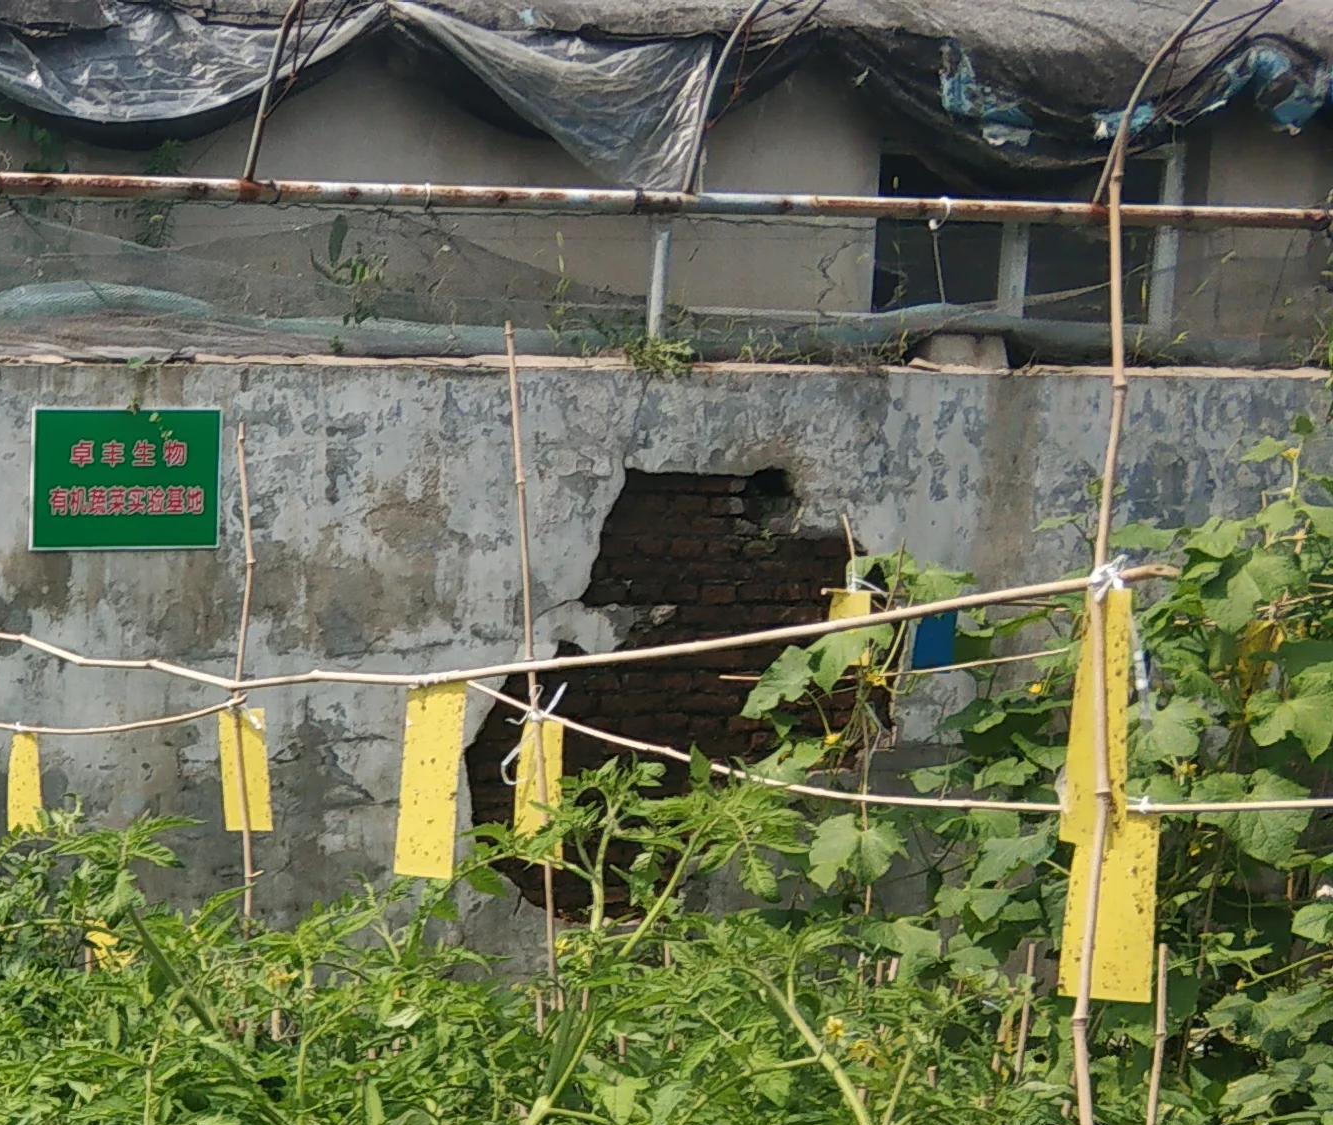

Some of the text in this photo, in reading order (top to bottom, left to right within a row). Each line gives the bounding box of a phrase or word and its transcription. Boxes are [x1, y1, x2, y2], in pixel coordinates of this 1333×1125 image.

[70, 440, 187, 467] 卓丰生物
[49, 485, 205, 516] 有机蔬菜实验基地
